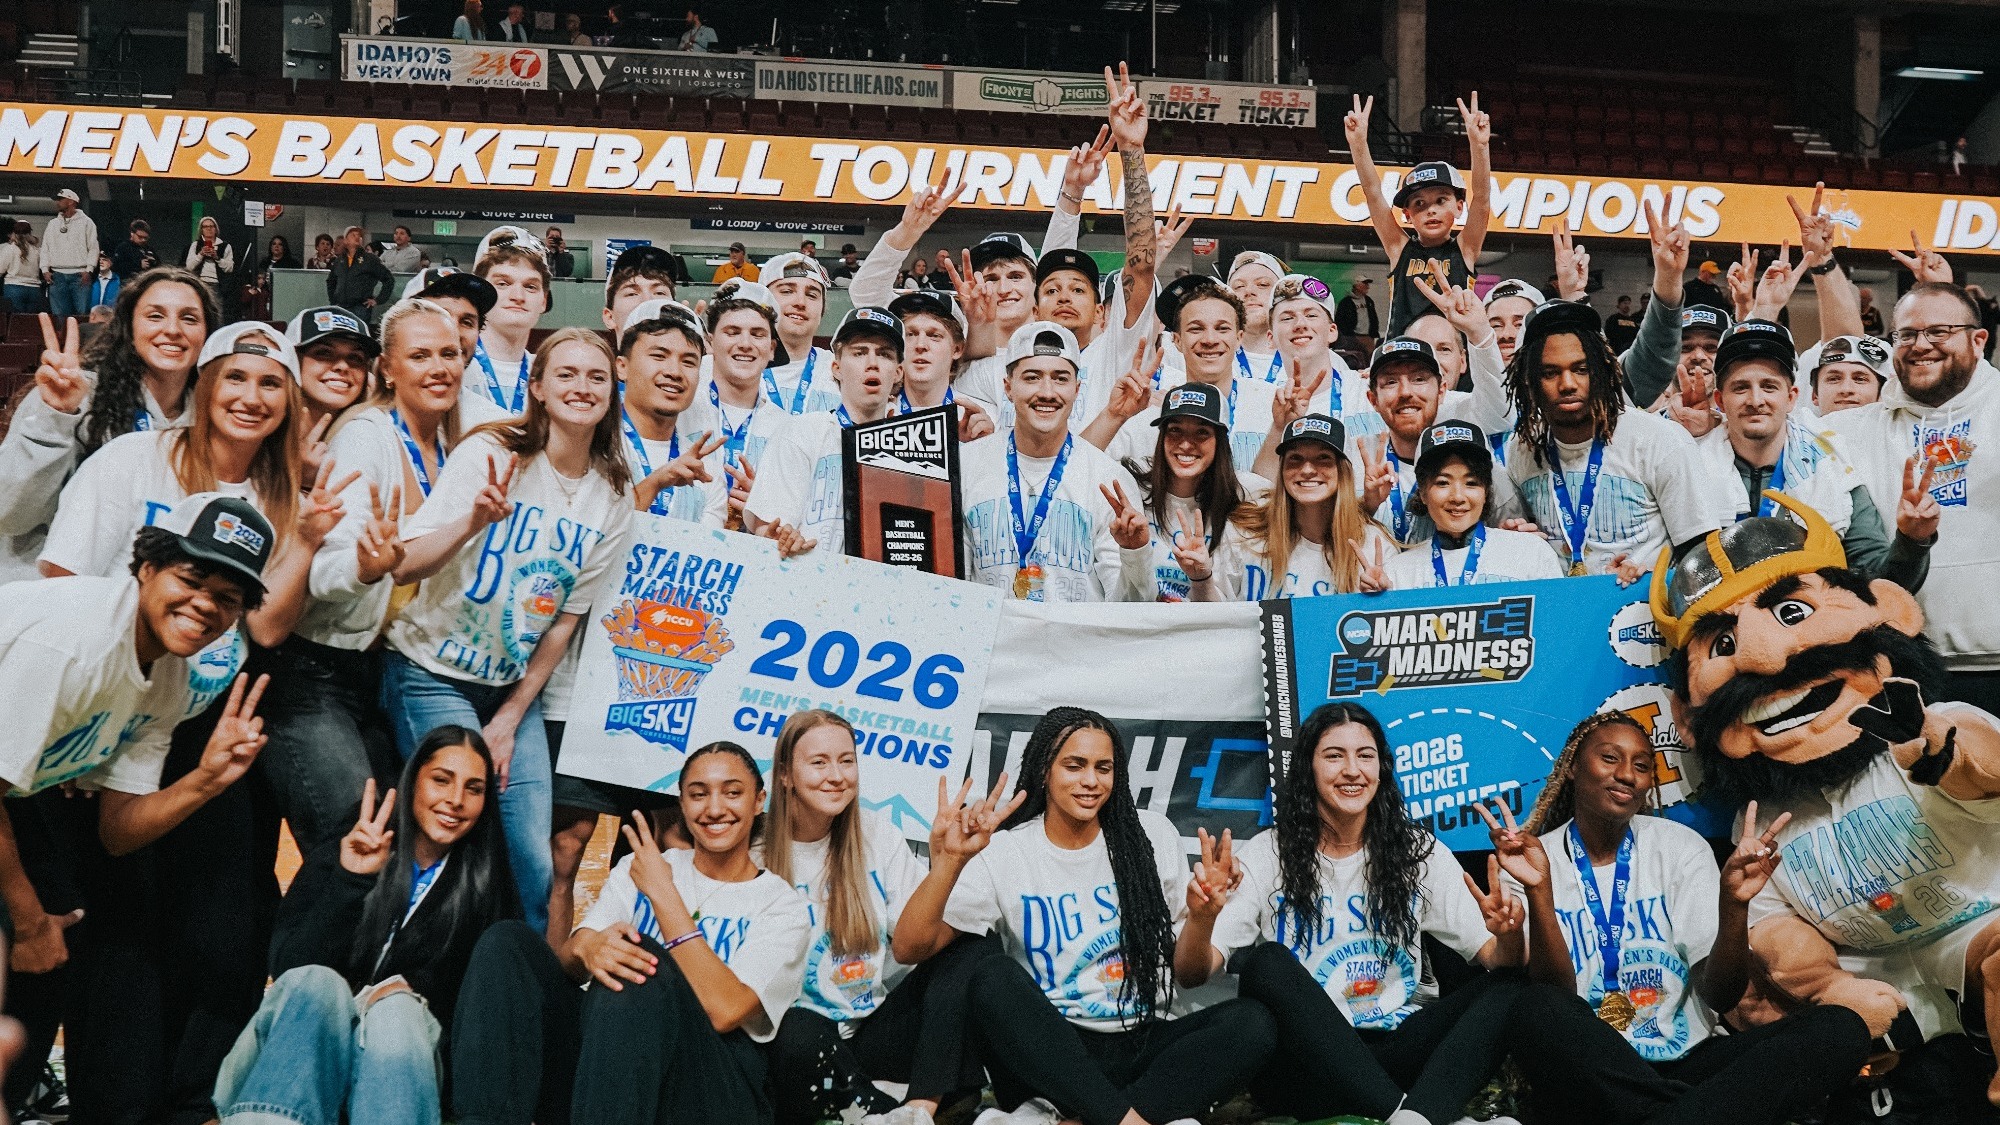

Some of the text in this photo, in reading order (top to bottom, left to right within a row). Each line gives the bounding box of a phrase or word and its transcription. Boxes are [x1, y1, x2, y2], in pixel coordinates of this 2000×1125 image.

[357, 44, 452, 65] IDAHO'S
[357, 65, 451, 82] VERY OWN
[623, 66, 746, 80] ONE SIXTEEN & WEST
[688, 80, 721, 88] LODGE
[759, 69, 938, 98] IDAHOSTEELHEADS.COM
[985, 83, 1023, 97] FRONT
[1065, 88, 1106, 99] FIGHTS
[1149, 93, 1165, 101] THE
[1240, 98, 1255, 106] THE
[1148, 100, 1221, 122] TICKET
[1239, 105, 1309, 126] TICKET
[0, 108, 257, 176] MEN'S
[270, 120, 785, 197] BASKETBALL
[1330, 168, 1726, 239] CMPIONS
[1932, 200, 2000, 250] ID
[870, 311, 893, 325] 2026
[1692, 311, 1716, 321] 2026
[1395, 341, 1419, 351] 2026
[1181, 391, 1206, 402] 2026
[1305, 420, 1330, 430] 2026
[1445, 427, 1472, 437] 2026
[894, 451, 943, 460] CONFERENCE
[1931, 479, 1967, 501] GSKY
[895, 520, 915, 528] MEN'S
[885, 531, 926, 540] BASKETBALL
[465, 501, 544, 605] BIG
[886, 541, 925, 551] CHAMPIONS
[889, 553, 923, 562] 2025-26
[626, 543, 744, 595] STARCH
[620, 574, 733, 616] MADNESS
[666, 615, 694, 627] ICCU
[1373, 610, 1478, 647] MARCH
[749, 619, 965, 710] 2026
[1388, 637, 1529, 676] MADNESS
[1271, 614, 1293, 739] @MARCHMADNESSMBB
[739, 687, 955, 743] MEN'S BASKETBALL
[639, 730, 685, 744] CONFERENCE
[733, 706, 953, 770] CHPIONS
[1395, 733, 1464, 774] 2026
[1400, 762, 1470, 797] TICKET
[1404, 780, 1523, 835] NCHED
[1914, 875, 1967, 920] 26
[1021, 892, 1083, 992] BIG
[1083, 929, 1121, 961] WOMEN
[1345, 959, 1388, 975] STARCH
[1624, 949, 1653, 967] EN'S
